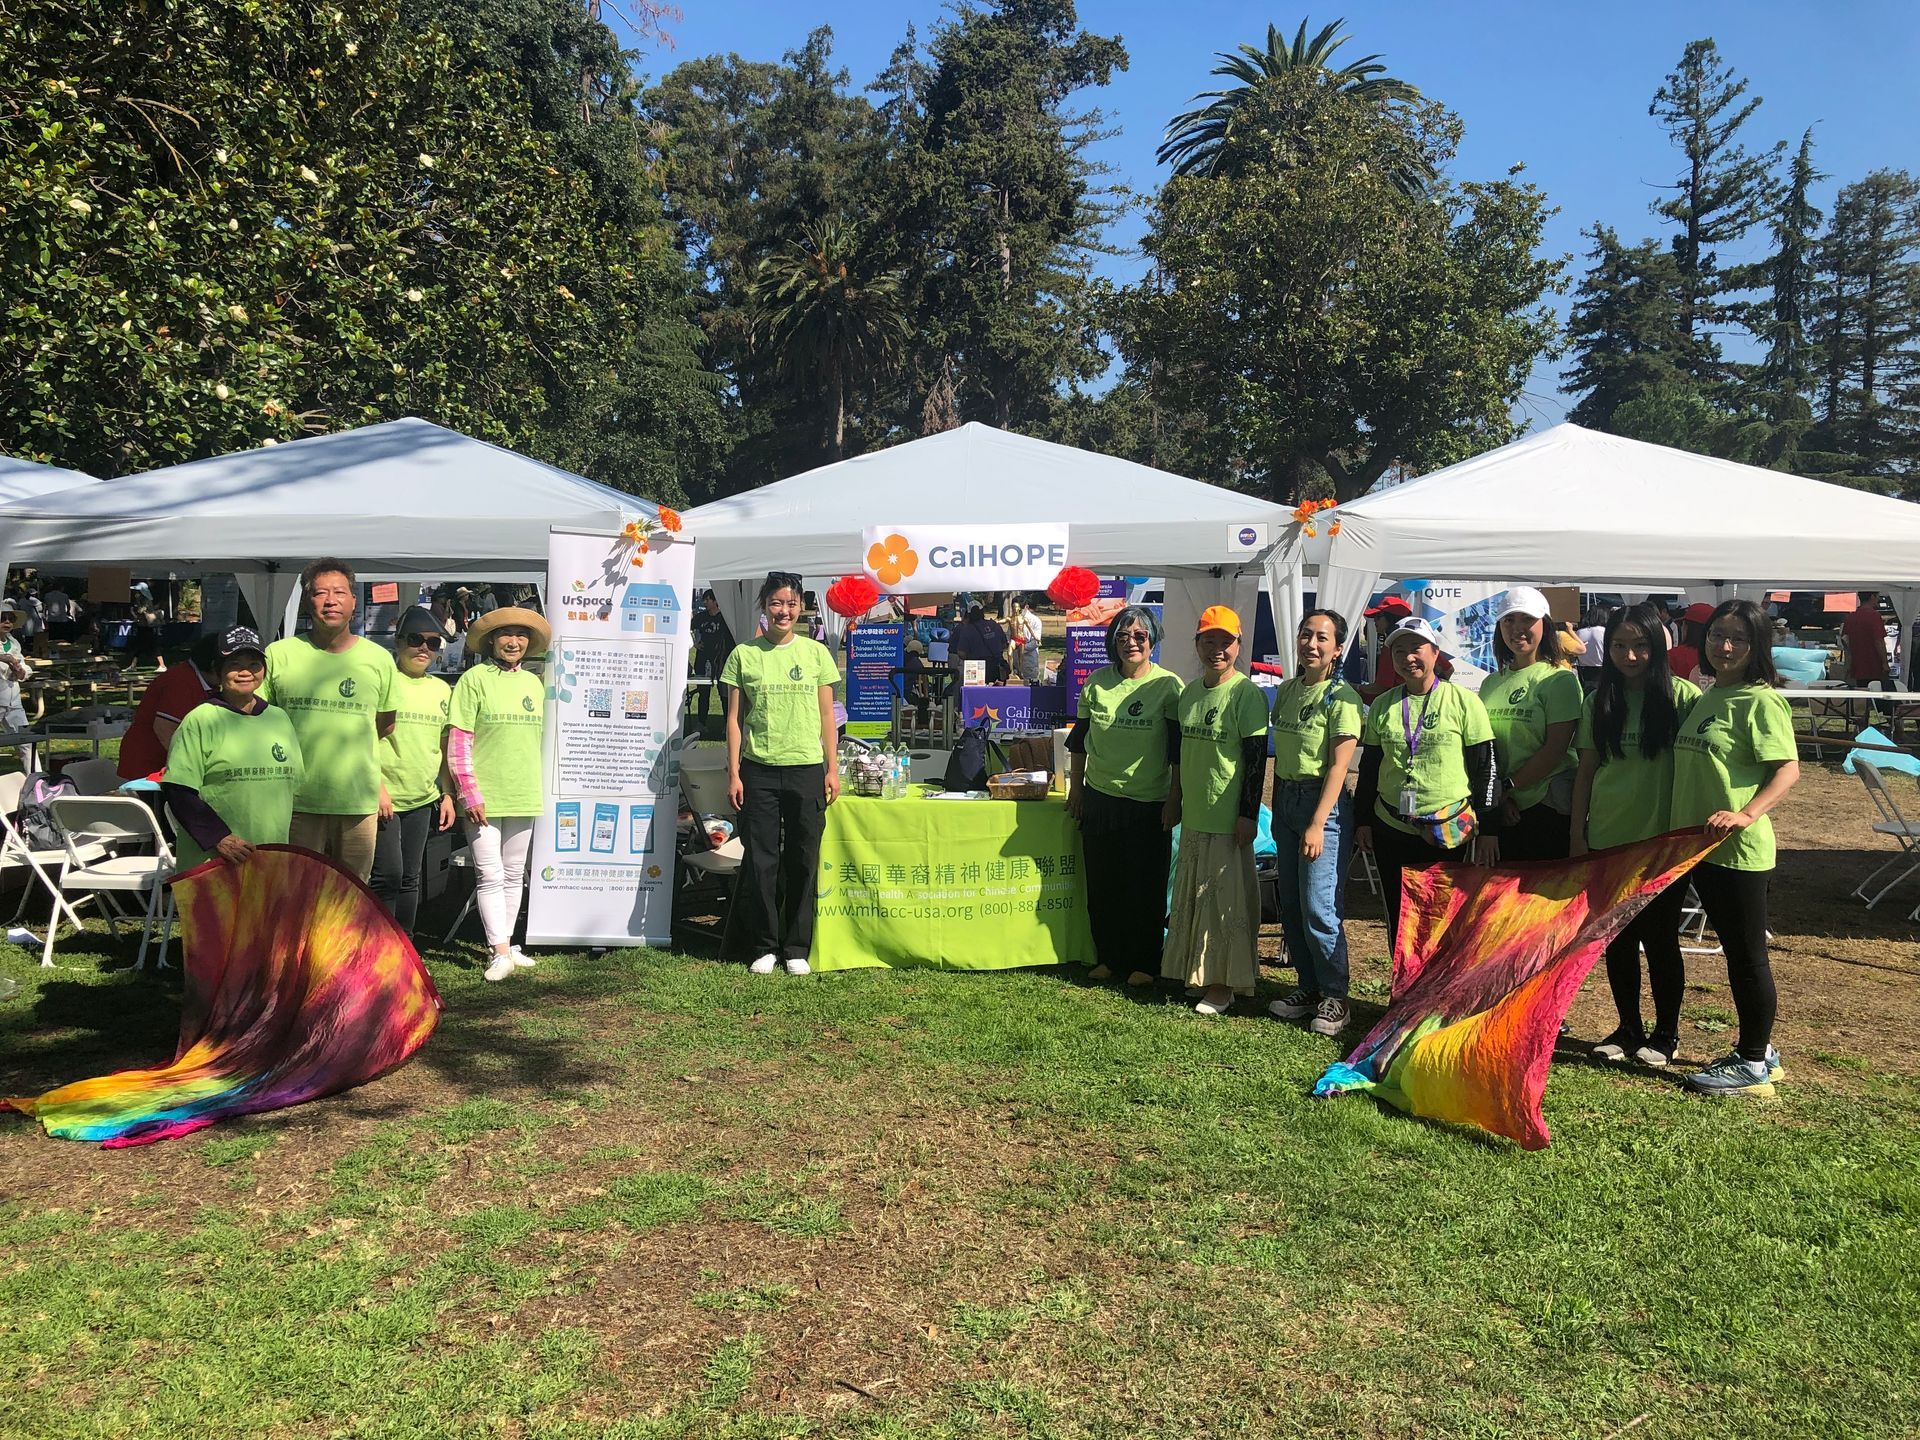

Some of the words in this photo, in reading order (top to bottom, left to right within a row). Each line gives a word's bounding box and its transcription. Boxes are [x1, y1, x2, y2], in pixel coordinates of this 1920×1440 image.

[928, 544, 1065, 568] CalHOPE
[1424, 588, 1462, 599] QUTE
[562, 596, 613, 608] UrSpace
[1006, 706, 1065, 719] Californi
[840, 854, 1076, 885] 美國華裔精神健康聯盟
[906, 890, 960, 899] Asociation
[979, 886, 1016, 896] Chinese
[814, 902, 973, 920] www.mhacc-usa.org
[980, 897, 1073, 918] (800)-881-8502
